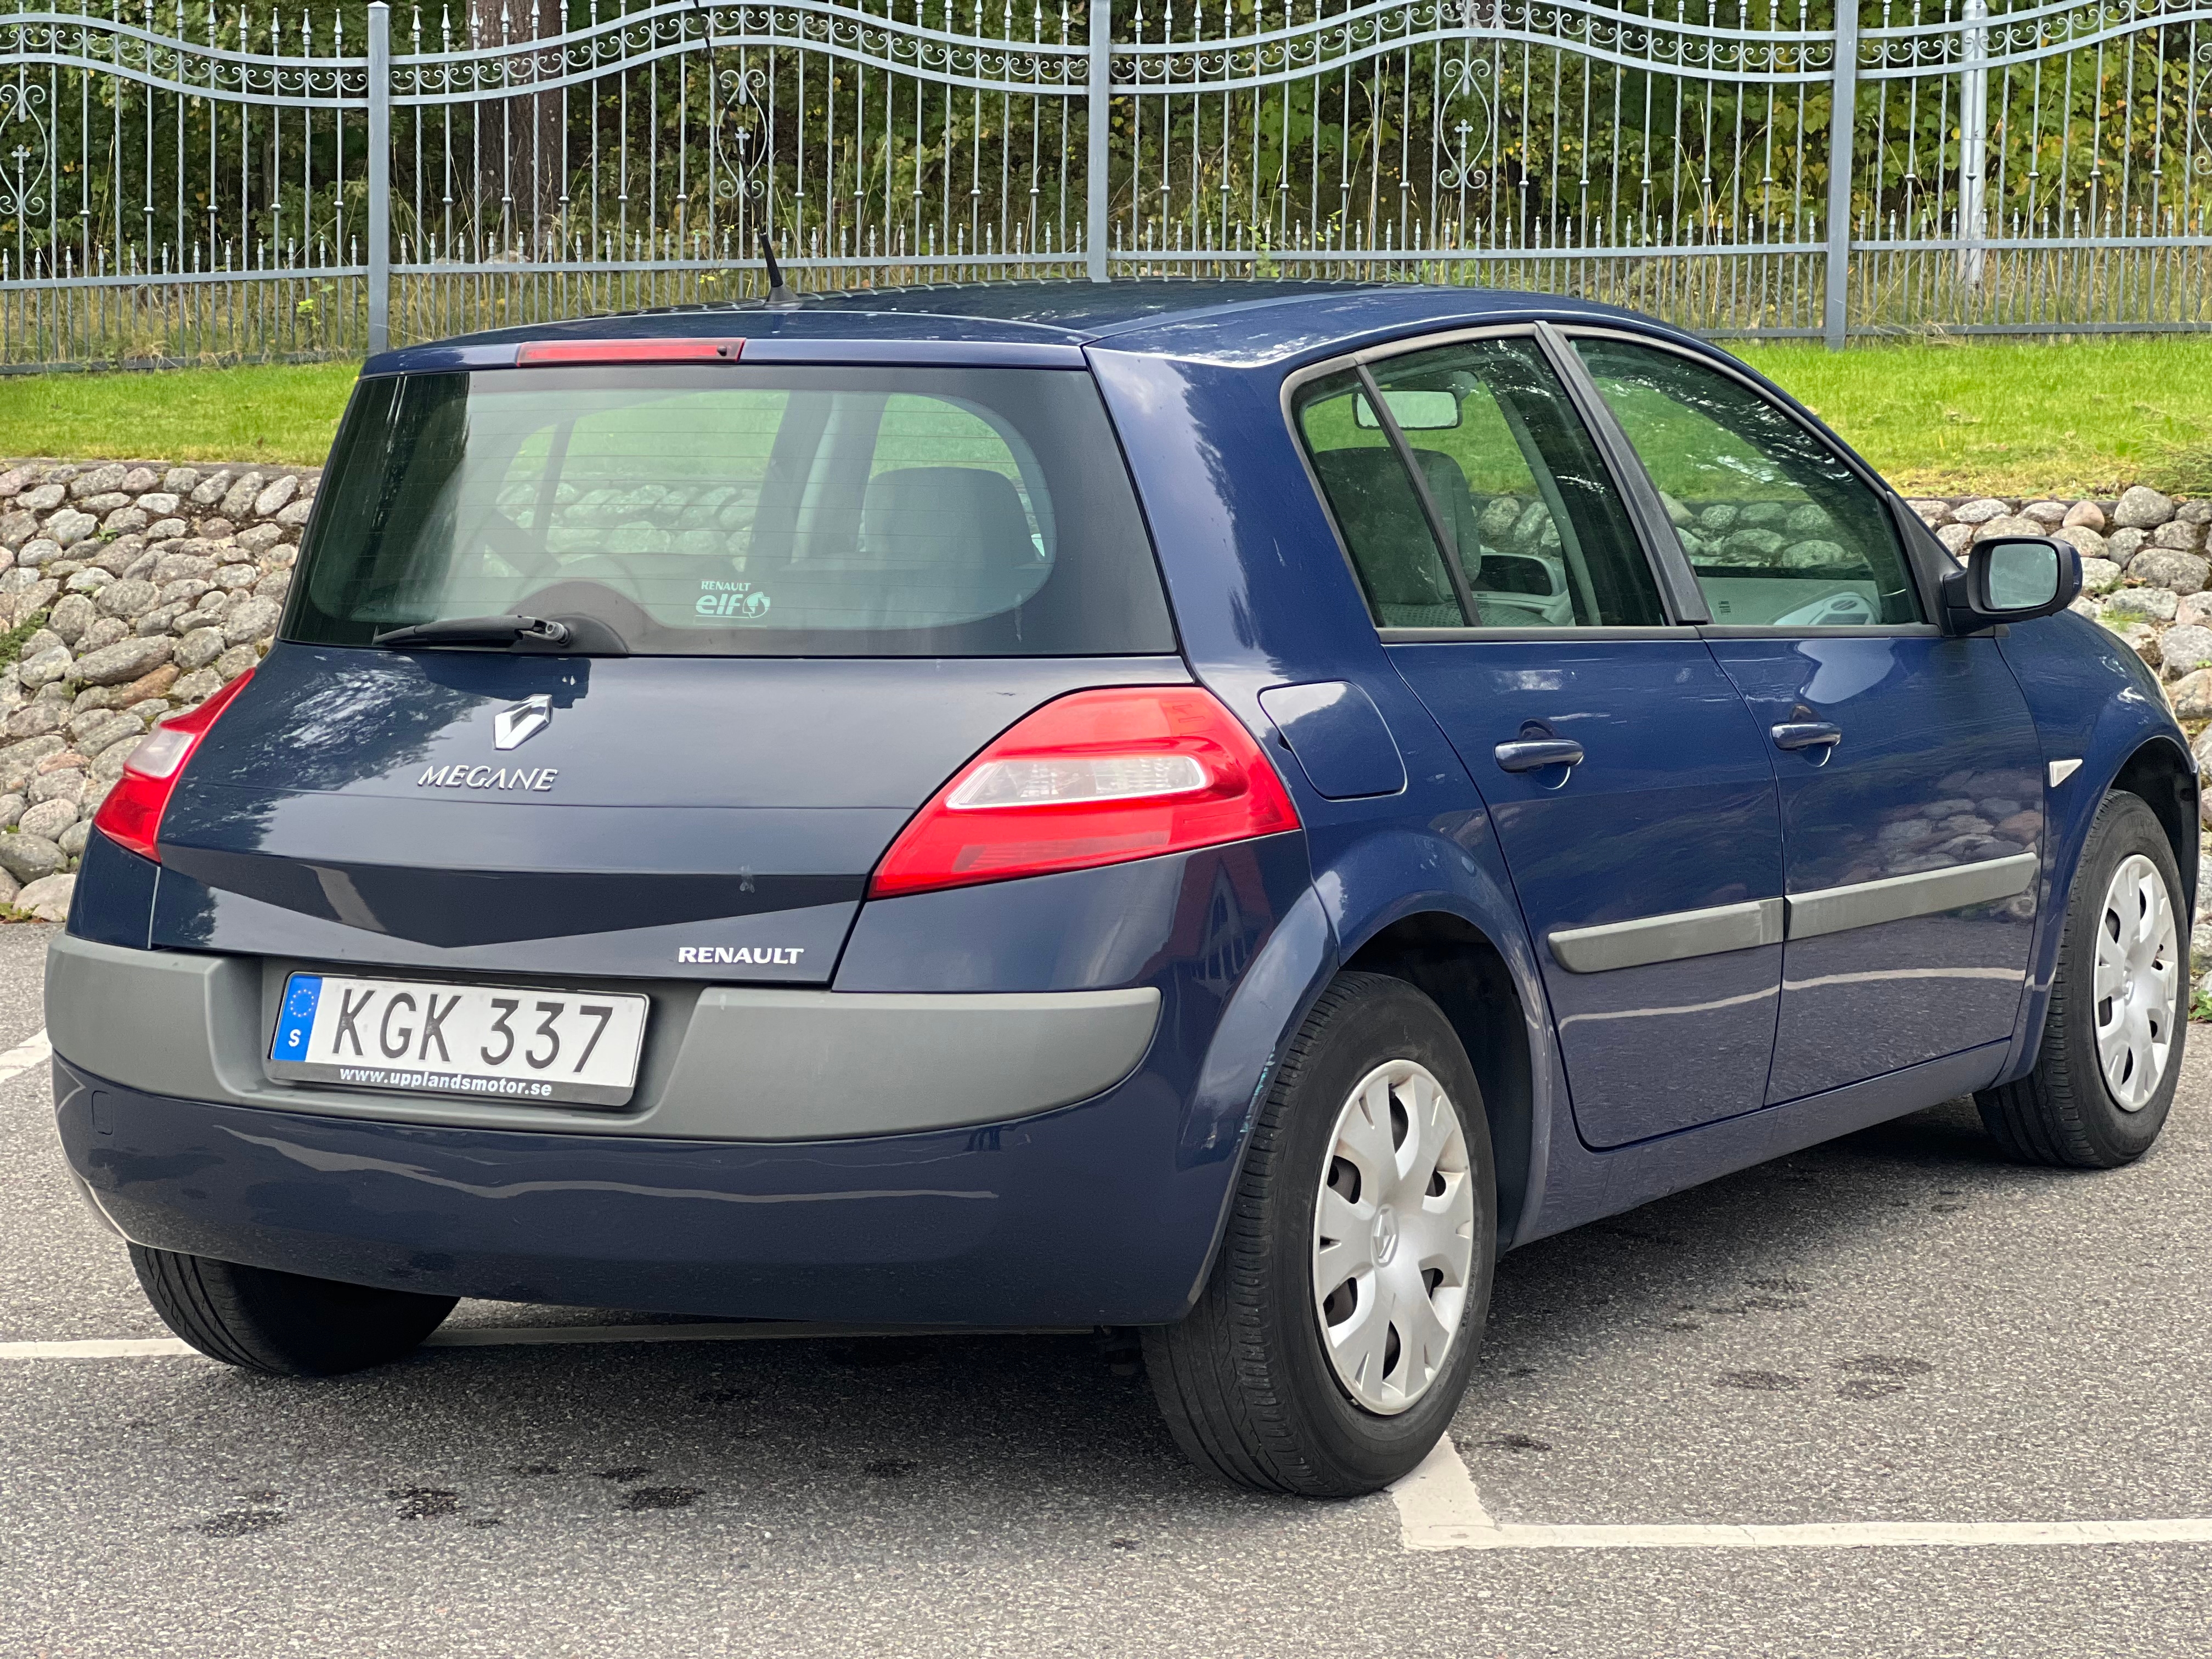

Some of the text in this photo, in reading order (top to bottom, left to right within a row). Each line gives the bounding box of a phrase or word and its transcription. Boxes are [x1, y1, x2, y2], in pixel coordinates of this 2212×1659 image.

[701, 580, 751, 591] RENAULT
[695, 594, 743, 614] elf
[417, 765, 558, 791] MEGANE
[678, 947, 804, 964] RENAULT
[288, 1029, 302, 1047] S
[331, 989, 613, 1074] KGK 337
[340, 1068, 552, 1096] www.upplandsmotor.se
